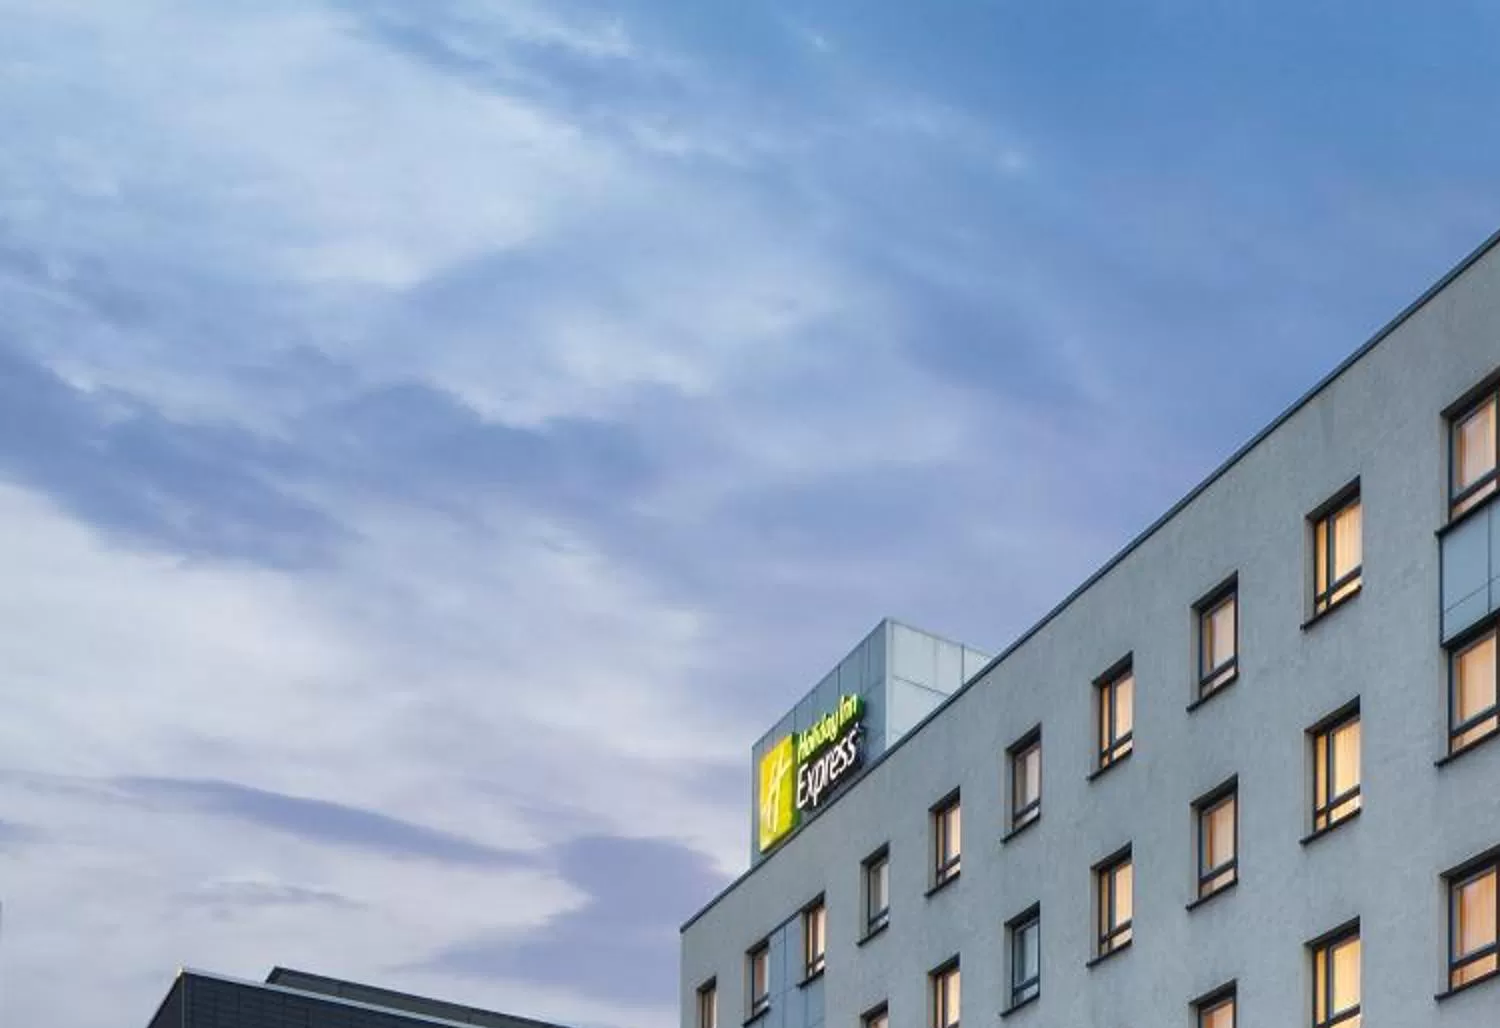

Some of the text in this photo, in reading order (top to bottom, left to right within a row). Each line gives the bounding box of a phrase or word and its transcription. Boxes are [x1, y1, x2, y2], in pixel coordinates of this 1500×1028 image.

[797, 693, 858, 764] Holiday Inn
[796, 729, 858, 809] Express
